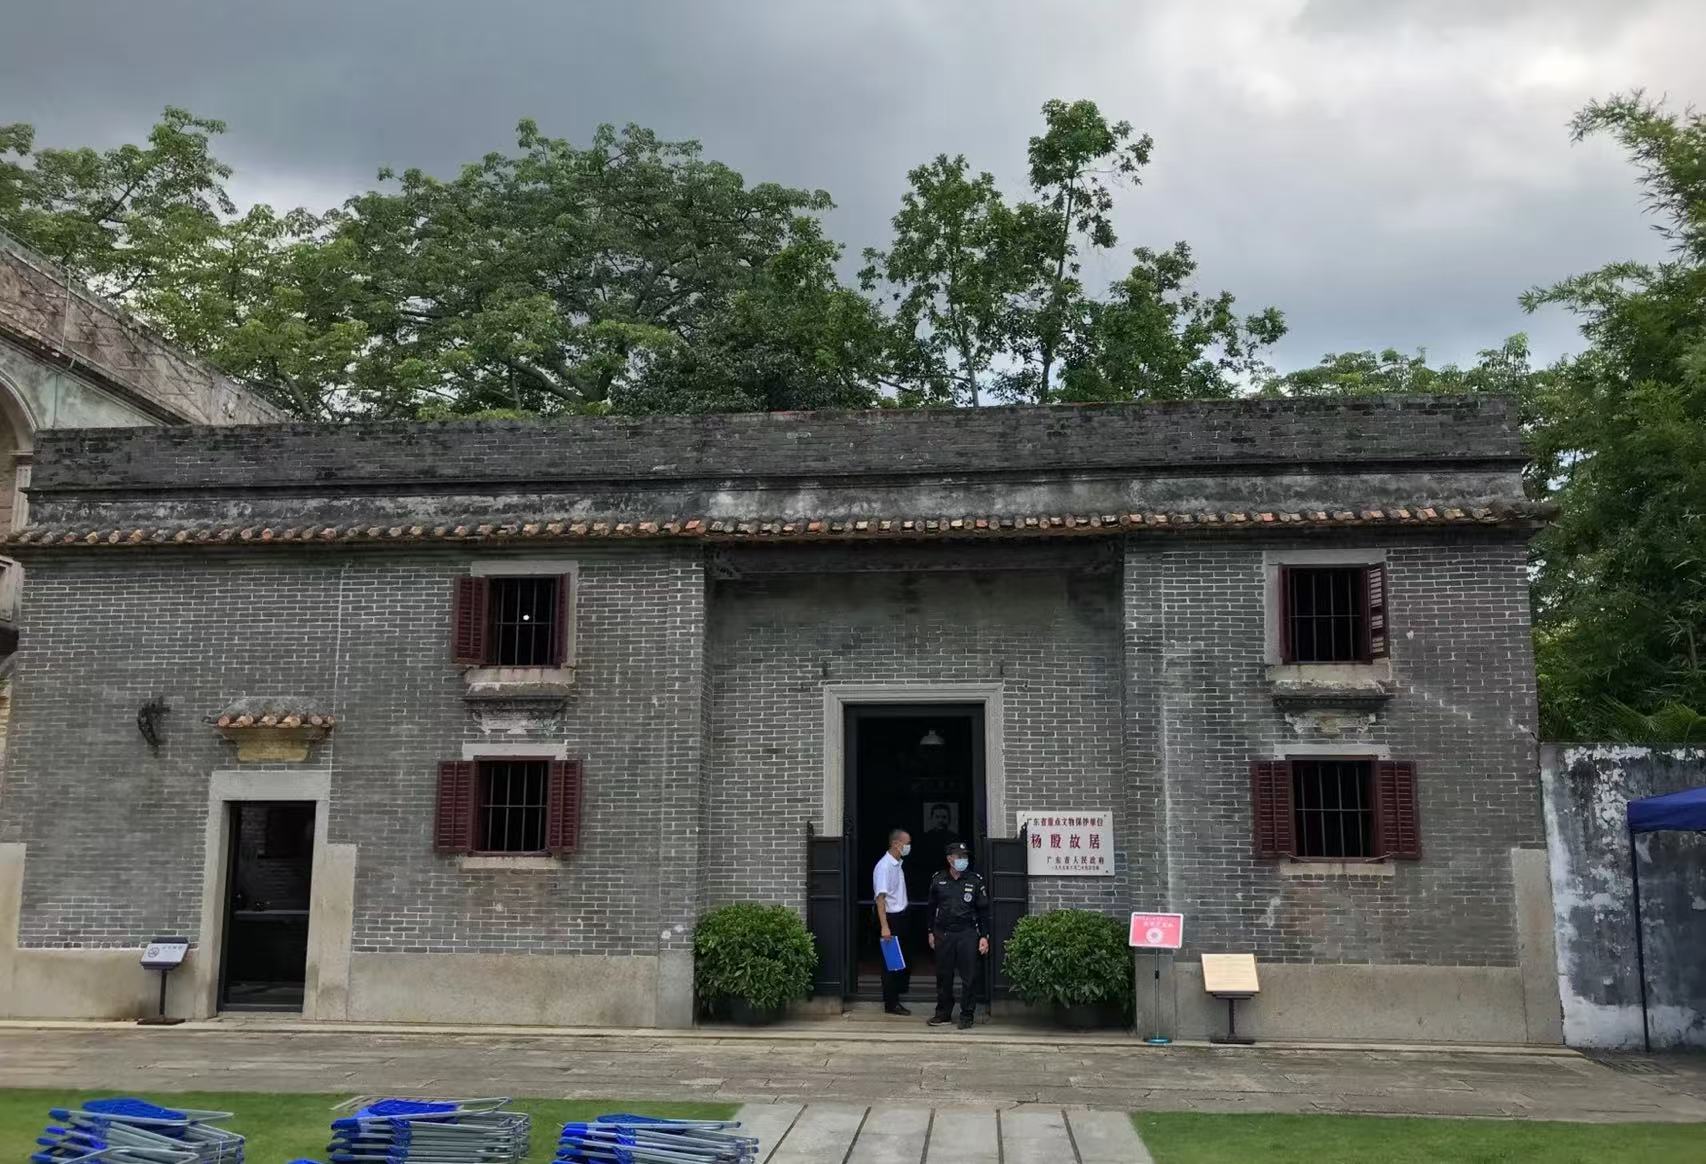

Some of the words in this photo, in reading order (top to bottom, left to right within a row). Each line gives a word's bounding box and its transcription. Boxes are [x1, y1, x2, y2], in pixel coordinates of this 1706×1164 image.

[1031, 833, 1100, 849] 杨殷故居
[1047, 855, 1105, 865] 广东省人民政府
